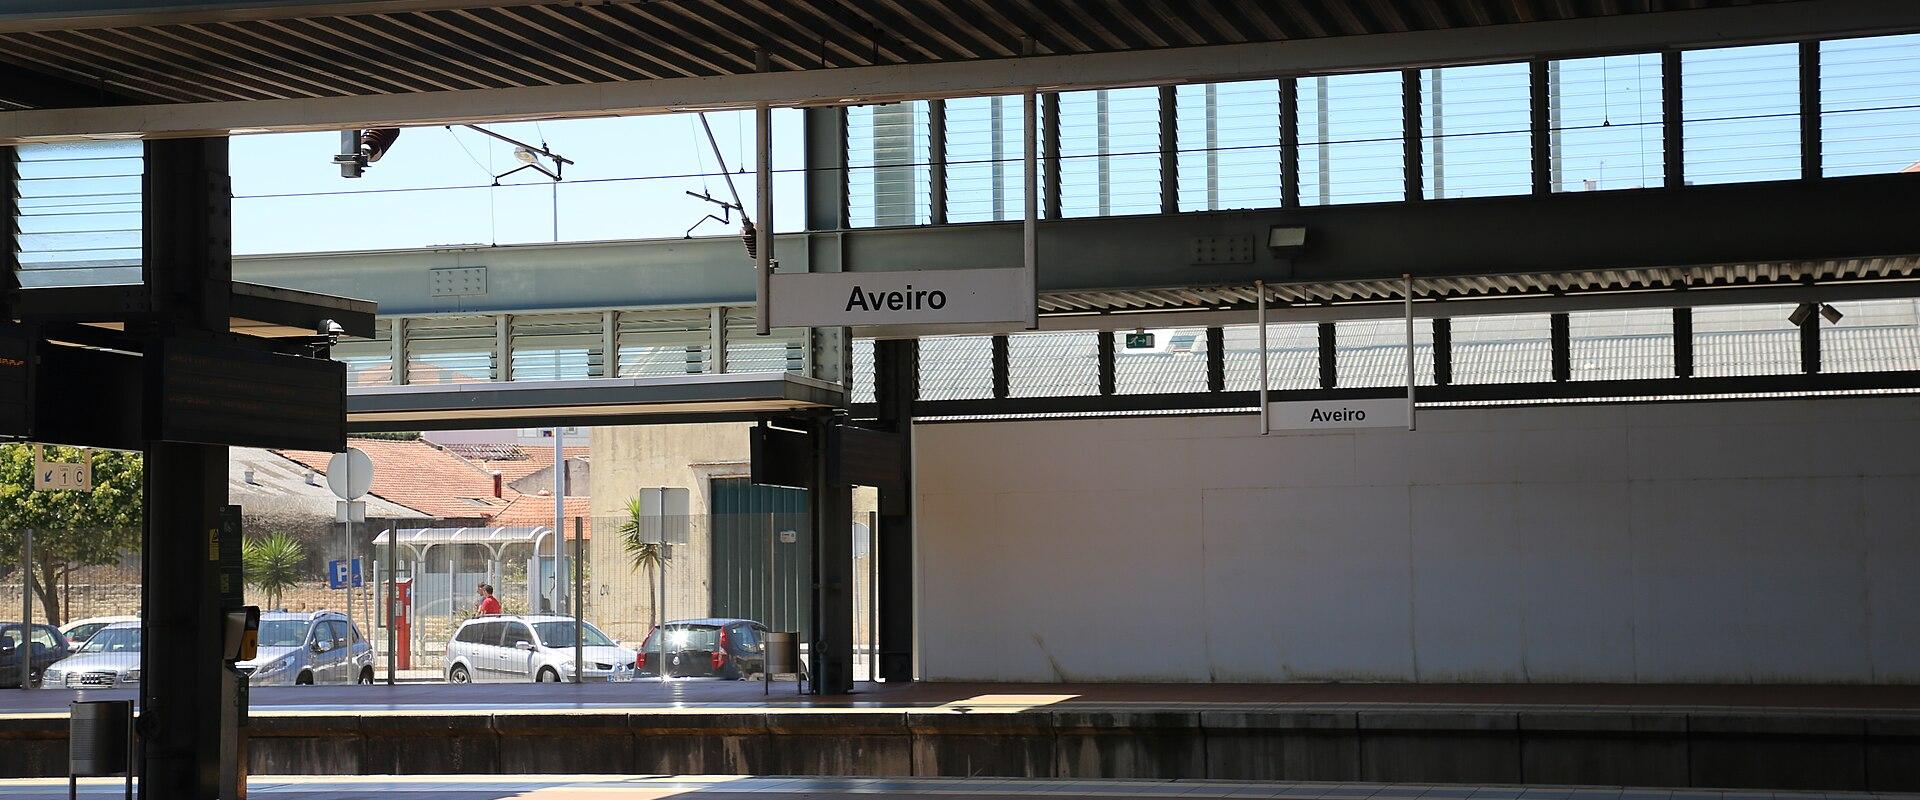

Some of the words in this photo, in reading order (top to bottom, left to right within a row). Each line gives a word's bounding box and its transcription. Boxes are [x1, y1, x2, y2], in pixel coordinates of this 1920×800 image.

[845, 284, 947, 312] Aveiro
[1309, 407, 1366, 422] Aveiro
[62, 472, 67, 484] 1
[76, 471, 83, 483] C
